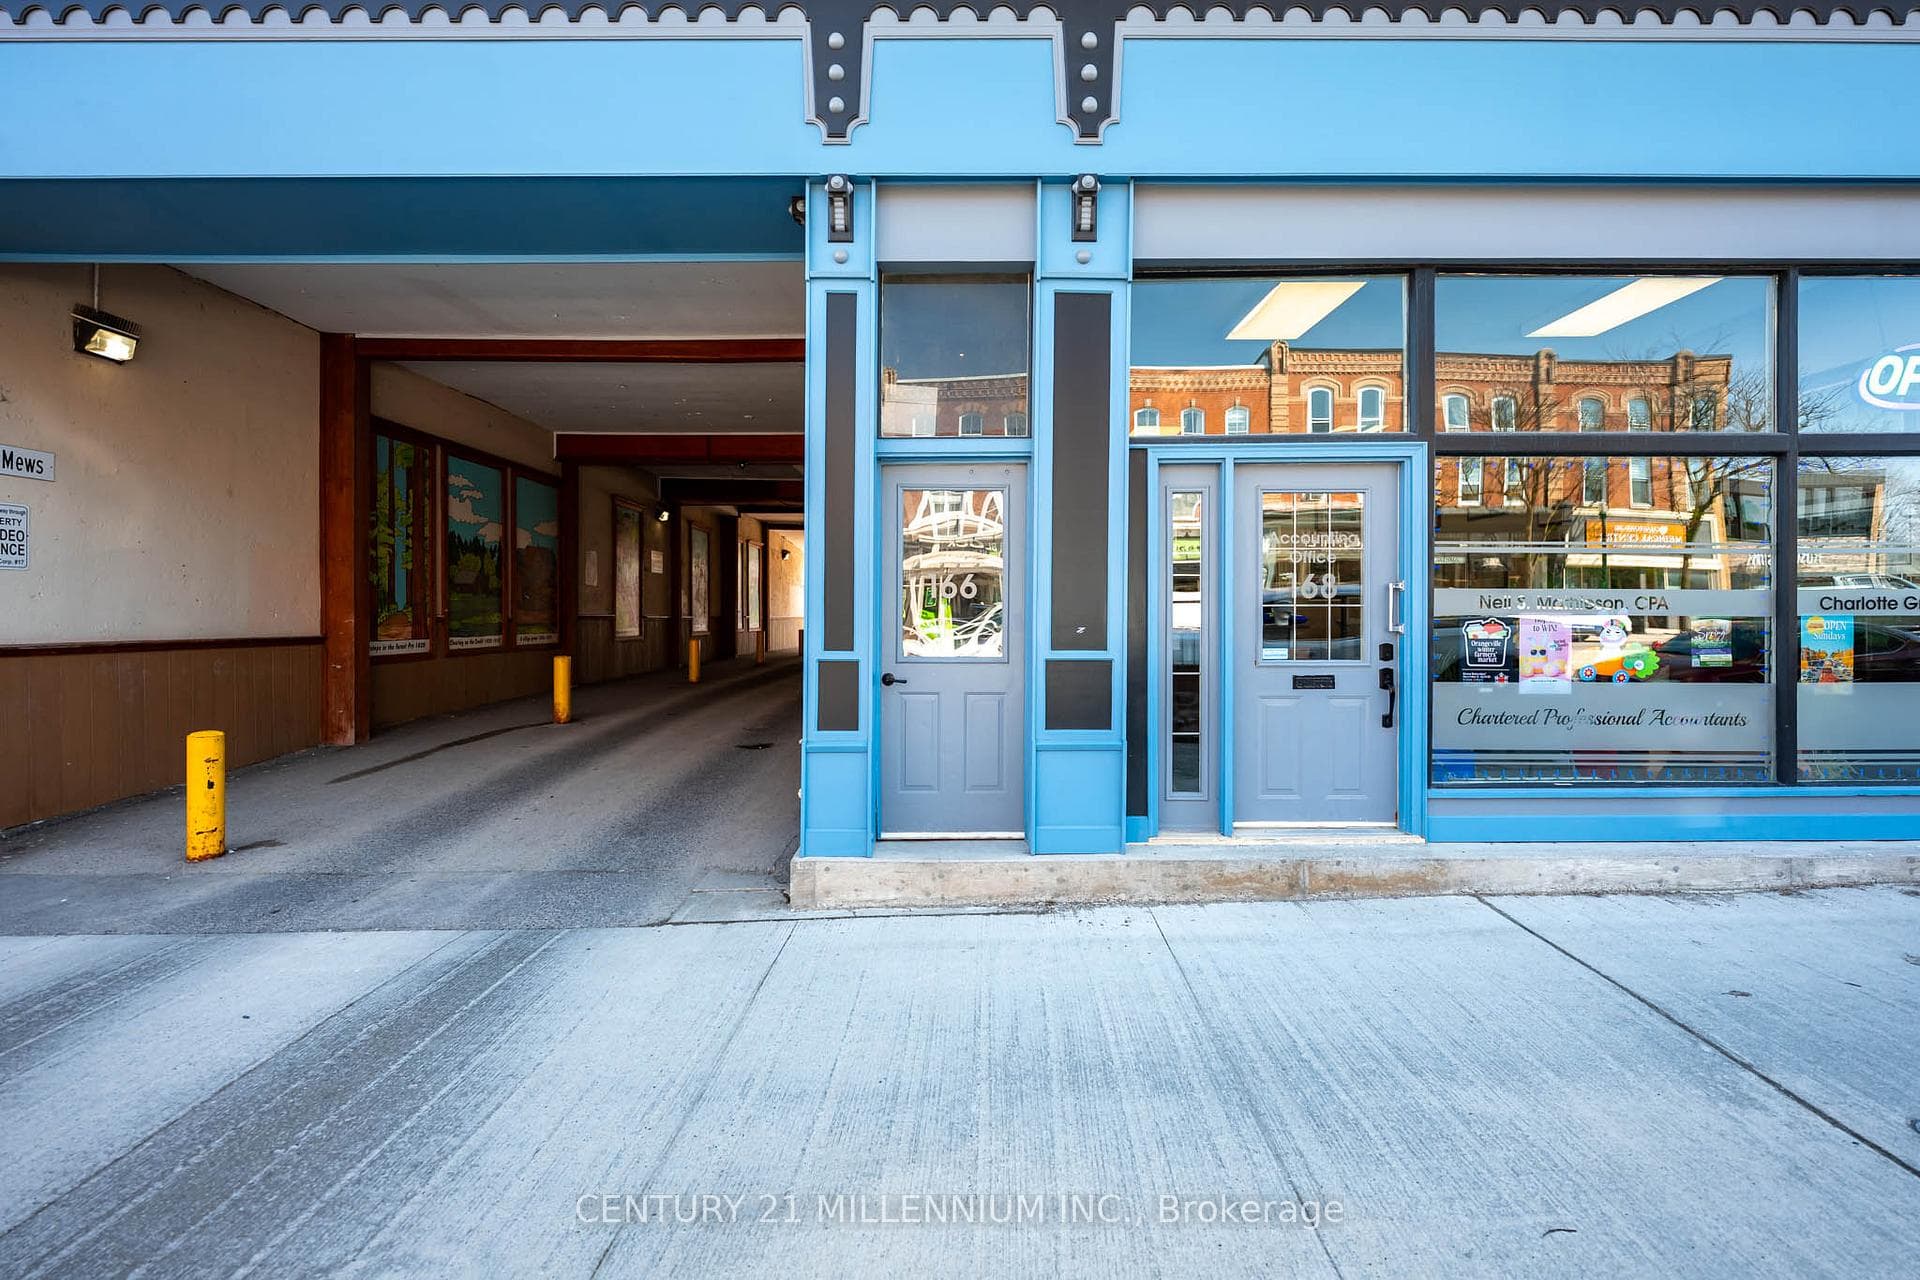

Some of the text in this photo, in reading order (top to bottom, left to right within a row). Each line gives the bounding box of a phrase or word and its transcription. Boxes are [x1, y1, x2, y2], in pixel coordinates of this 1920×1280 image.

[2, 450, 44, 474] Mews
[1271, 531, 1360, 548] Accounting
[1290, 551, 1337, 563] Office
[930, 573, 978, 599] 166
[1289, 573, 1338, 599] 168
[1480, 595, 1511, 609] Neil
[1635, 595, 1669, 610] CPA
[1820, 596, 1920, 610] Charlotte G
[1824, 620, 1847, 631] OPEN
[1471, 640, 1501, 648] Orangeville
[1457, 707, 1540, 725] Chartered
